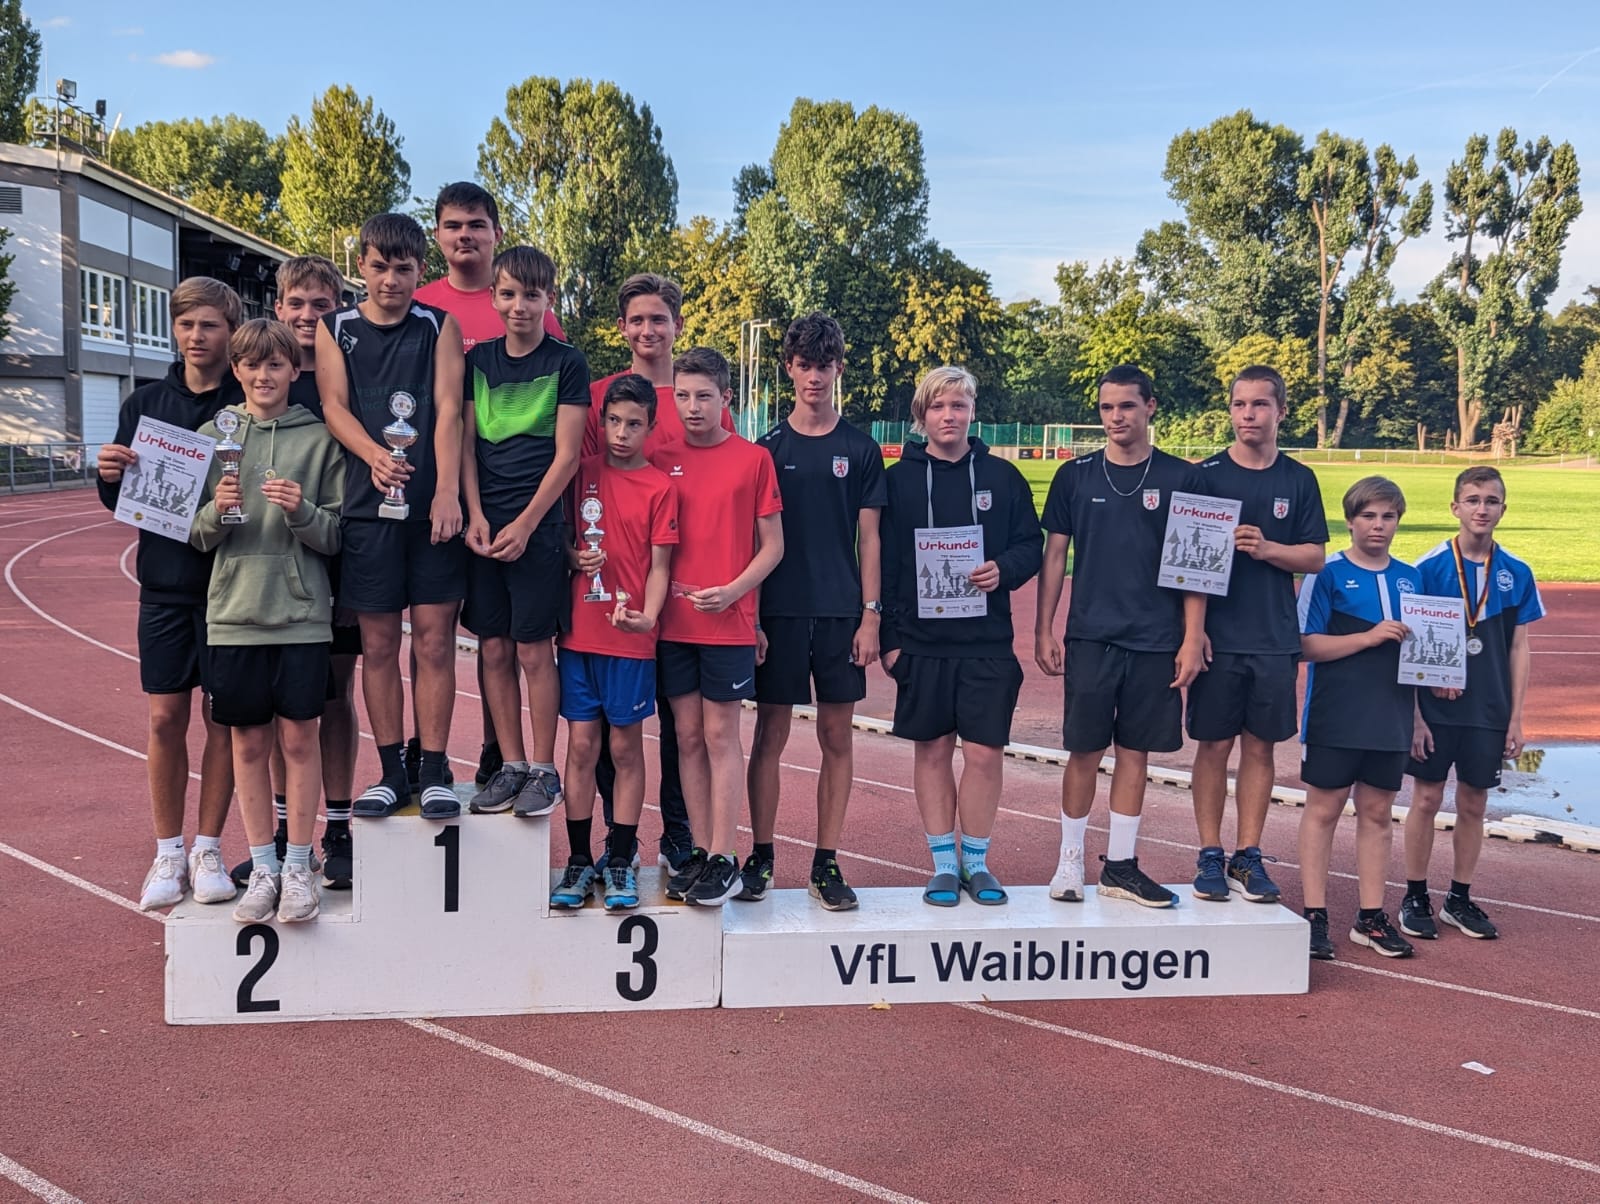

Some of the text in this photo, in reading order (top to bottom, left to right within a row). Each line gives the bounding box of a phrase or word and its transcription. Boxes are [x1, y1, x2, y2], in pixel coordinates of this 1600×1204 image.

[138, 432, 206, 461] Urkunde
[1172, 504, 1234, 522] Urkunde
[918, 539, 979, 551] Urkunde
[1403, 606, 1460, 619] Urkunde
[434, 825, 460, 912] 1
[235, 924, 281, 1013] 2
[615, 915, 659, 1001] 3
[830, 940, 1210, 991] VfL Waiblingen
